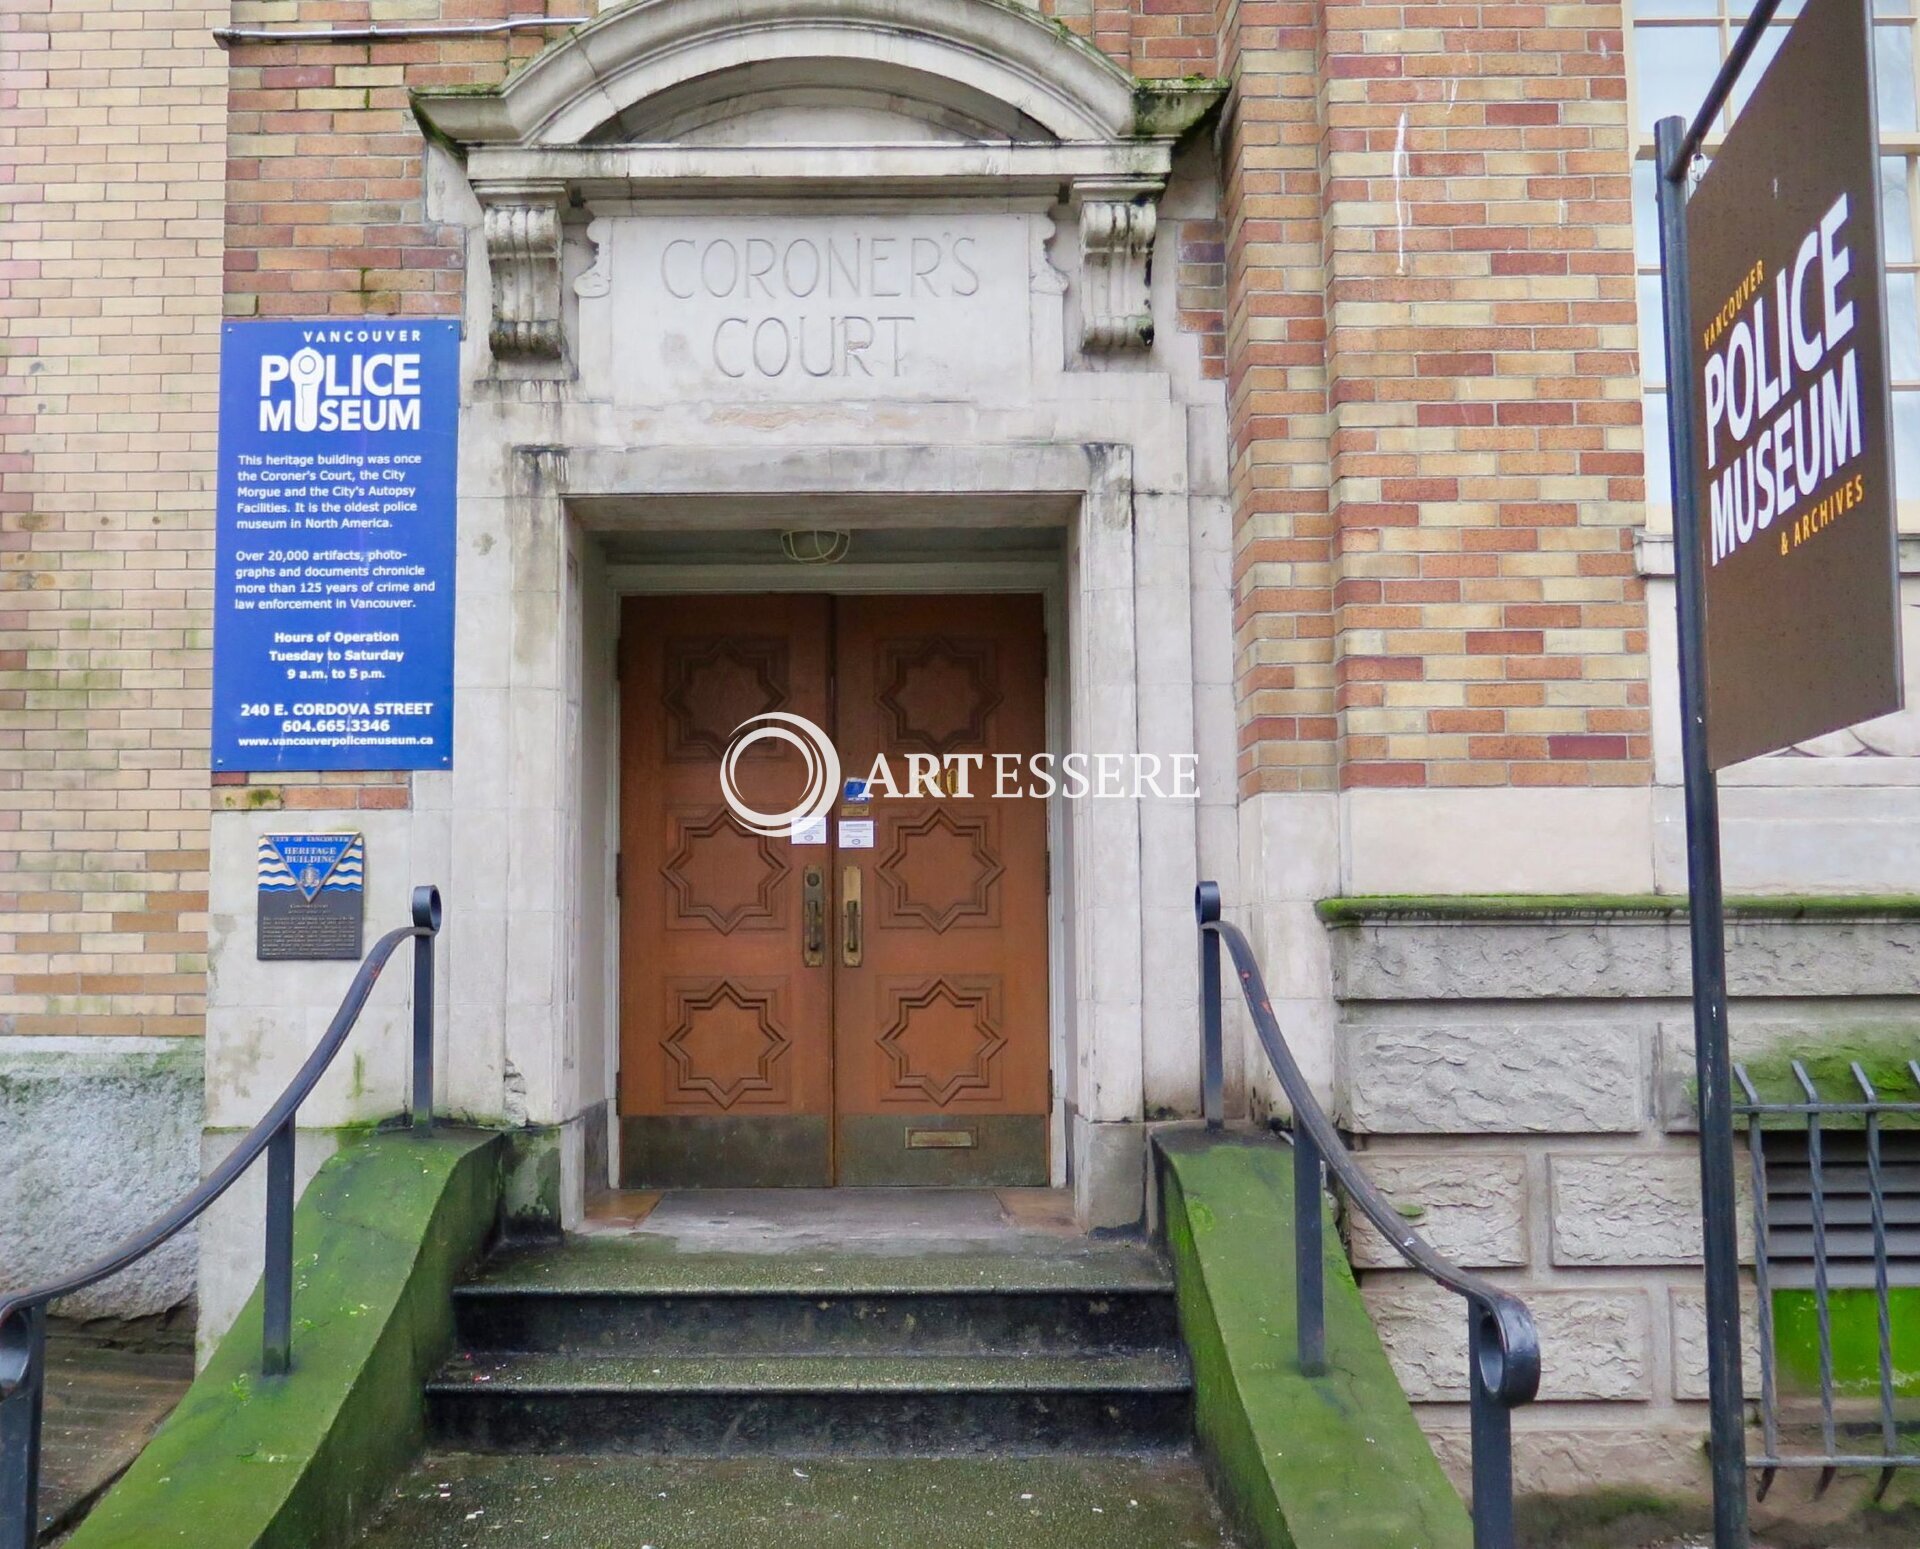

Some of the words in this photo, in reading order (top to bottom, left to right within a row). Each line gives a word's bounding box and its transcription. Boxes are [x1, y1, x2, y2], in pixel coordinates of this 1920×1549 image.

[660, 232, 980, 299] CORONER'S
[1703, 259, 1764, 351] VANCOUVER
[304, 330, 420, 342] VANCOUVER
[1704, 192, 1854, 470] POLICE
[713, 316, 916, 378] COURT
[260, 347, 421, 398] POLICE
[260, 398, 420, 432] MUSEUM
[238, 455, 262, 465] This
[266, 455, 313, 467] heritage
[318, 455, 363, 466] building
[368, 456, 390, 464] was
[1710, 348, 1861, 567] MUSEUM
[238, 471, 257, 481] the
[261, 471, 316, 481] Coroner's
[320, 471, 355, 482] Court,
[360, 470, 379, 480] the
[383, 470, 405, 481] City
[238, 487, 280, 499] Morgue
[284, 487, 306, 497] and
[310, 486, 329, 496] the
[332, 486, 365, 498] City's
[368, 486, 415, 497] Autopsy
[237, 503, 290, 513] Facilities.
[295, 503, 304, 512] It
[309, 503, 318, 512] is
[322, 502, 341, 512] the
[344, 502, 379, 512] oldest
[383, 501, 417, 513] police
[1780, 531, 1789, 556] &
[1793, 474, 1864, 545] ARCHIVES
[237, 521, 287, 529] museum
[291, 519, 301, 528] in
[306, 519, 338, 528] North
[341, 518, 392, 528] America.
[236, 551, 264, 561] Over
[268, 551, 309, 562] 20,000
[313, 550, 364, 562] artifacts,
[366, 550, 407, 562] photo-
[236, 567, 275, 579] graphs
[279, 567, 300, 577] and
[305, 567, 369, 576] documents
[373, 566, 425, 576] chronicle
[236, 585, 265, 593] more
[269, 583, 295, 593] than
[301, 583, 321, 592] 125
[326, 584, 358, 594] years
[361, 582, 374, 592] of
[377, 582, 409, 592] crime
[413, 581, 435, 591] and
[235, 599, 254, 609] law
[258, 599, 332, 609] enforcement
[336, 599, 346, 608] in
[351, 599, 415, 608] Vancouver.
[275, 633, 313, 642] Hours
[317, 632, 331, 642] of
[334, 632, 399, 644] Operation
[269, 650, 323, 663] Tuesday
[327, 650, 341, 661] to
[345, 650, 404, 662] Saturday
[287, 669, 296, 679] 9
[299, 671, 328, 679] a.m.
[332, 669, 345, 679] to
[349, 668, 358, 678] 5
[360, 671, 385, 680] p.m.
[241, 704, 270, 716] 240
[274, 704, 288, 715] E.
[293, 703, 370, 717] CORDOVA
[374, 703, 433, 715] STREET
[282, 719, 390, 732] 604.665.3346
[239, 735, 433, 747] www.vancouverpolicemuseum.ca
[284, 847, 337, 855] HERITAGE
[286, 855, 335, 863] BUILDING
